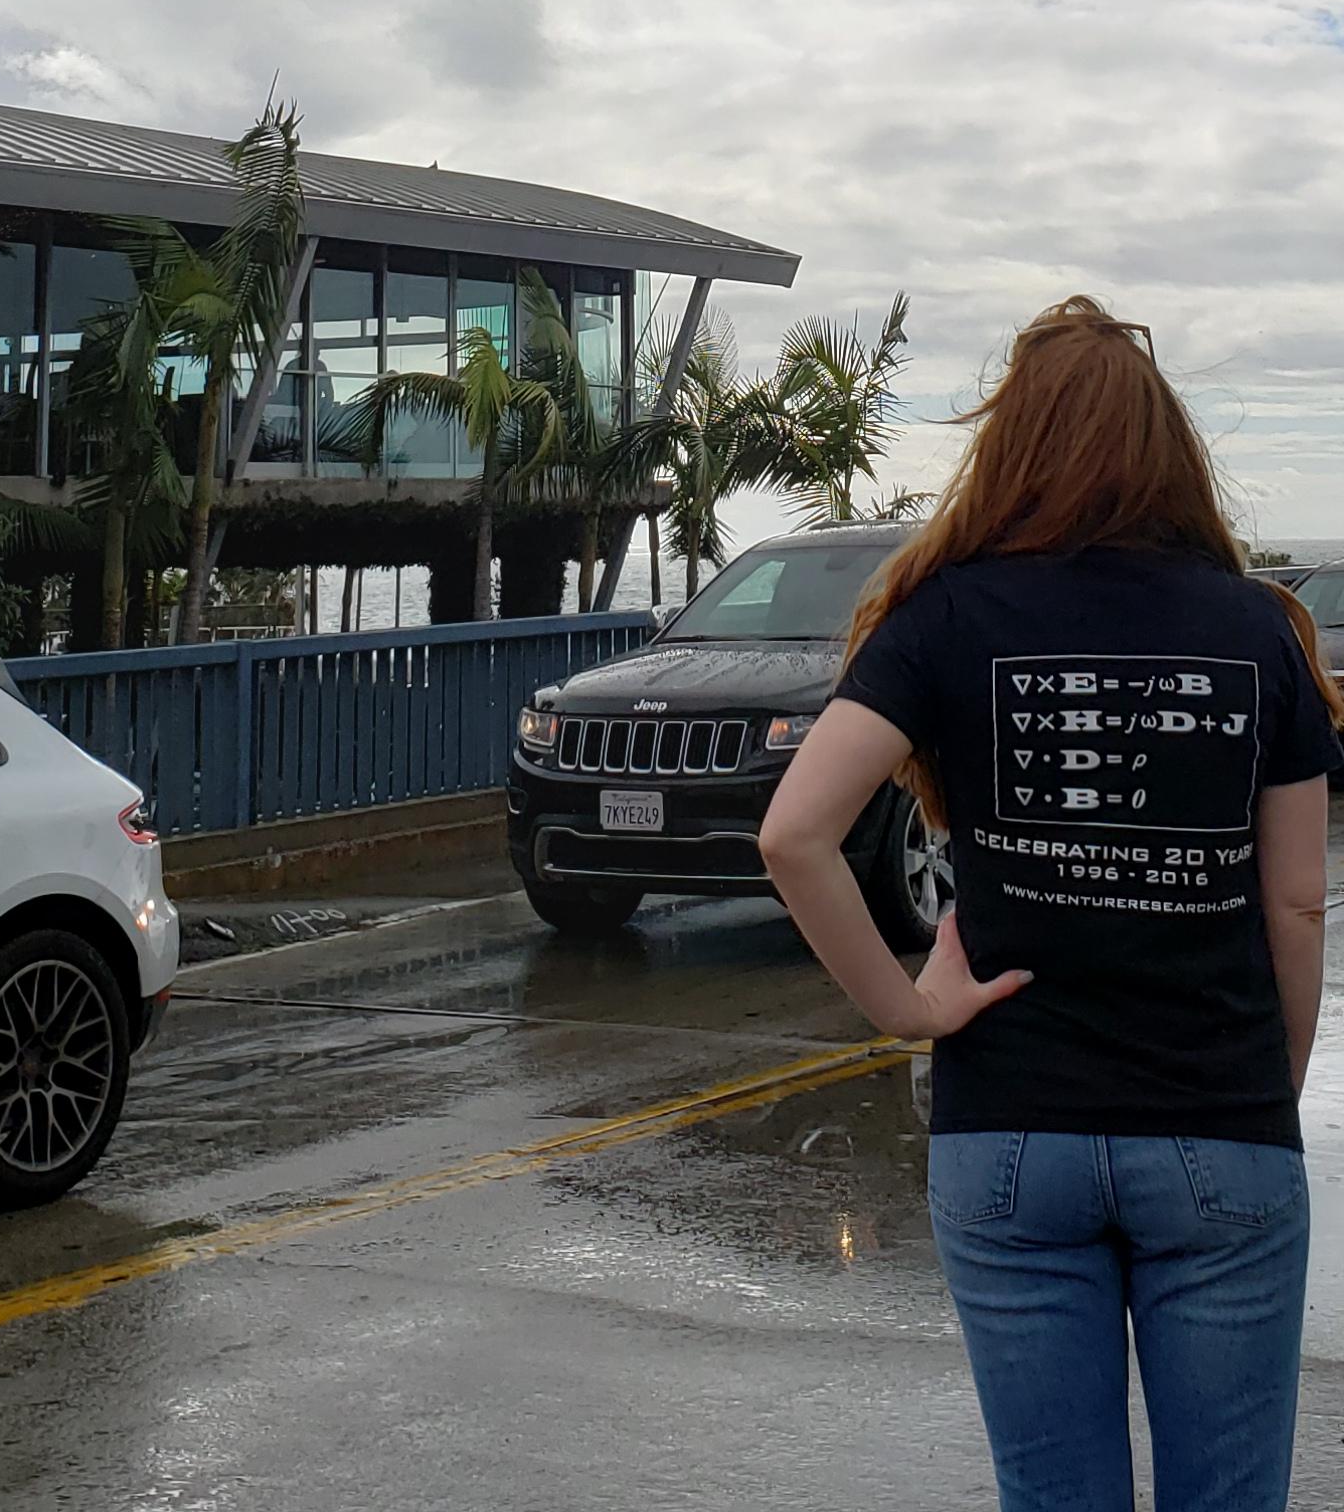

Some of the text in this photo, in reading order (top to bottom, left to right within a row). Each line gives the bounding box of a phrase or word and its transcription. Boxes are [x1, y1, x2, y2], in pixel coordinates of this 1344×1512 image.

[633, 698, 668, 713] Jeep
[604, 804, 660, 826] 7KYE249
[974, 827, 1150, 863] CELEBRATING
[1164, 847, 1205, 866] 20
[1056, 864, 1120, 881] 1996
[1145, 869, 1209, 886] 2016
[1003, 882, 1247, 914] WWW.VENTURERESEARCH.COM
